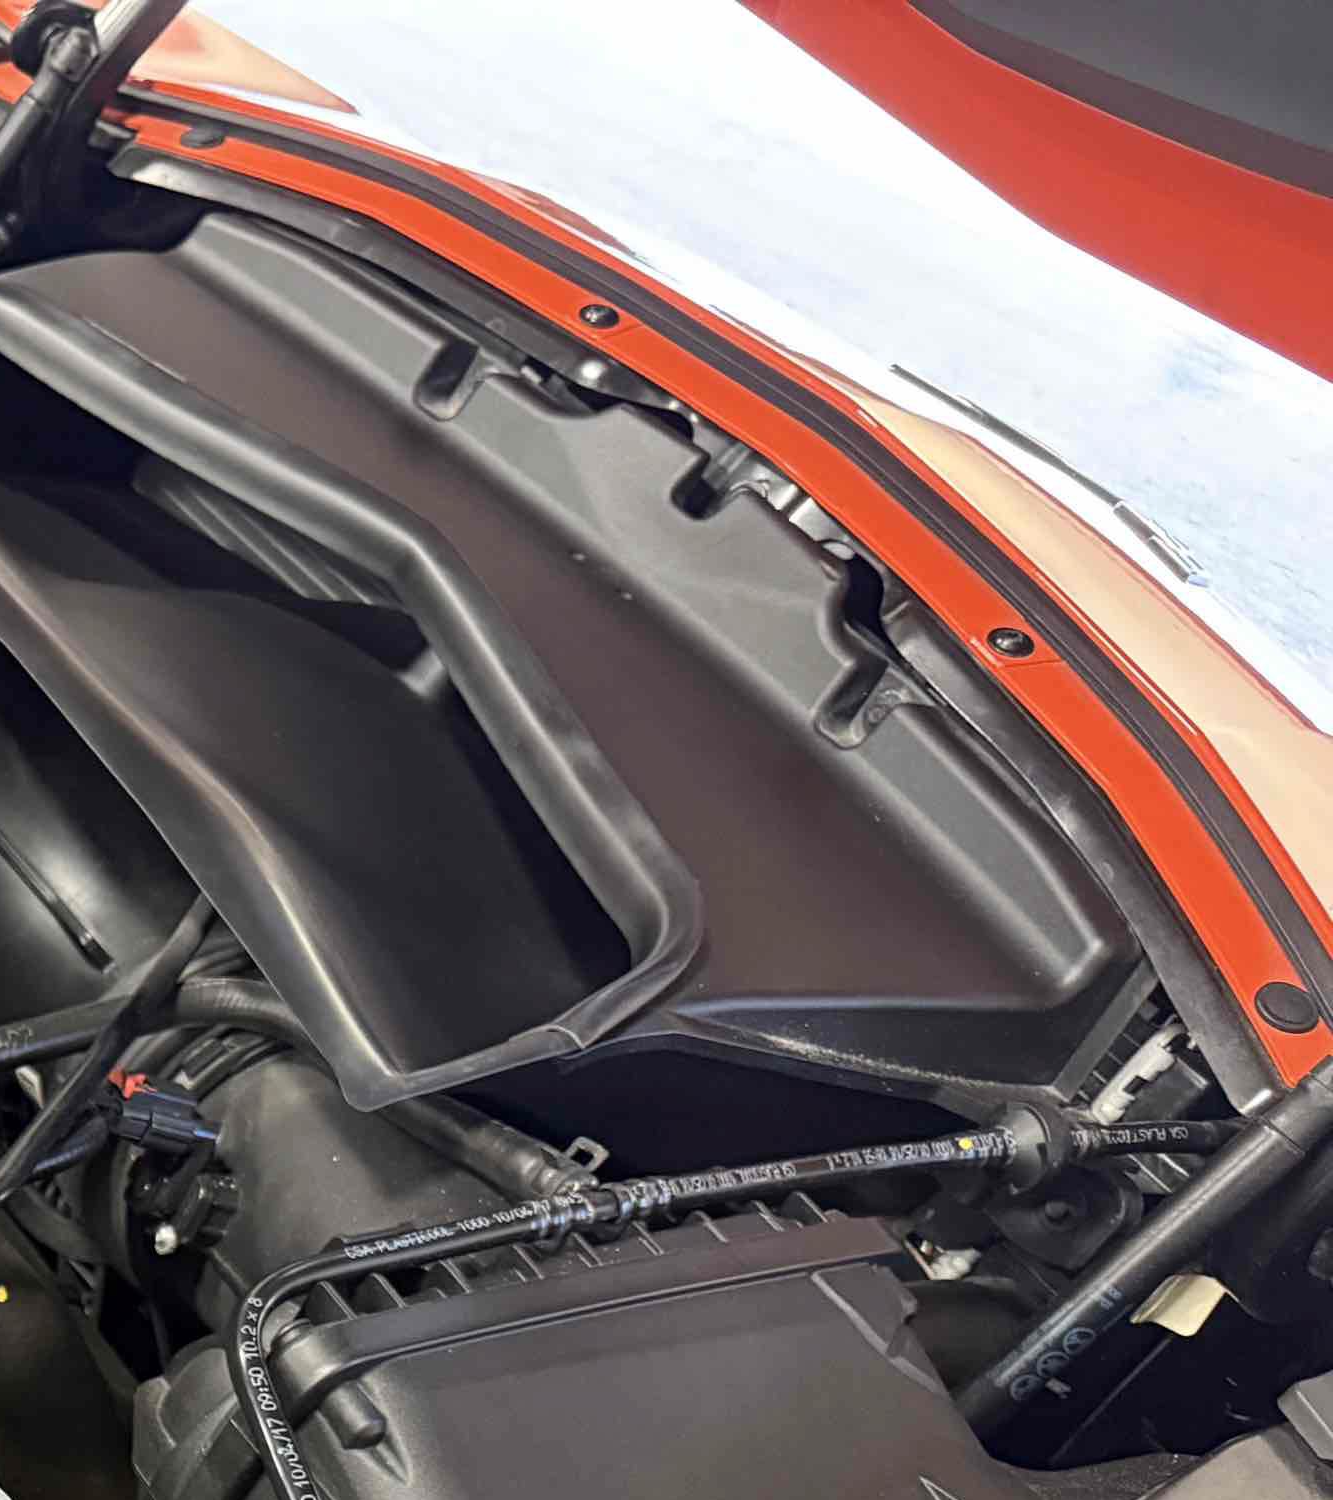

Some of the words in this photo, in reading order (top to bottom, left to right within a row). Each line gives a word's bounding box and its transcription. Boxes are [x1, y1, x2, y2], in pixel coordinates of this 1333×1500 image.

[247, 1296, 264, 1308] 8
[241, 1325, 260, 1361] 10.2
[248, 1366, 278, 1412] 09:50
